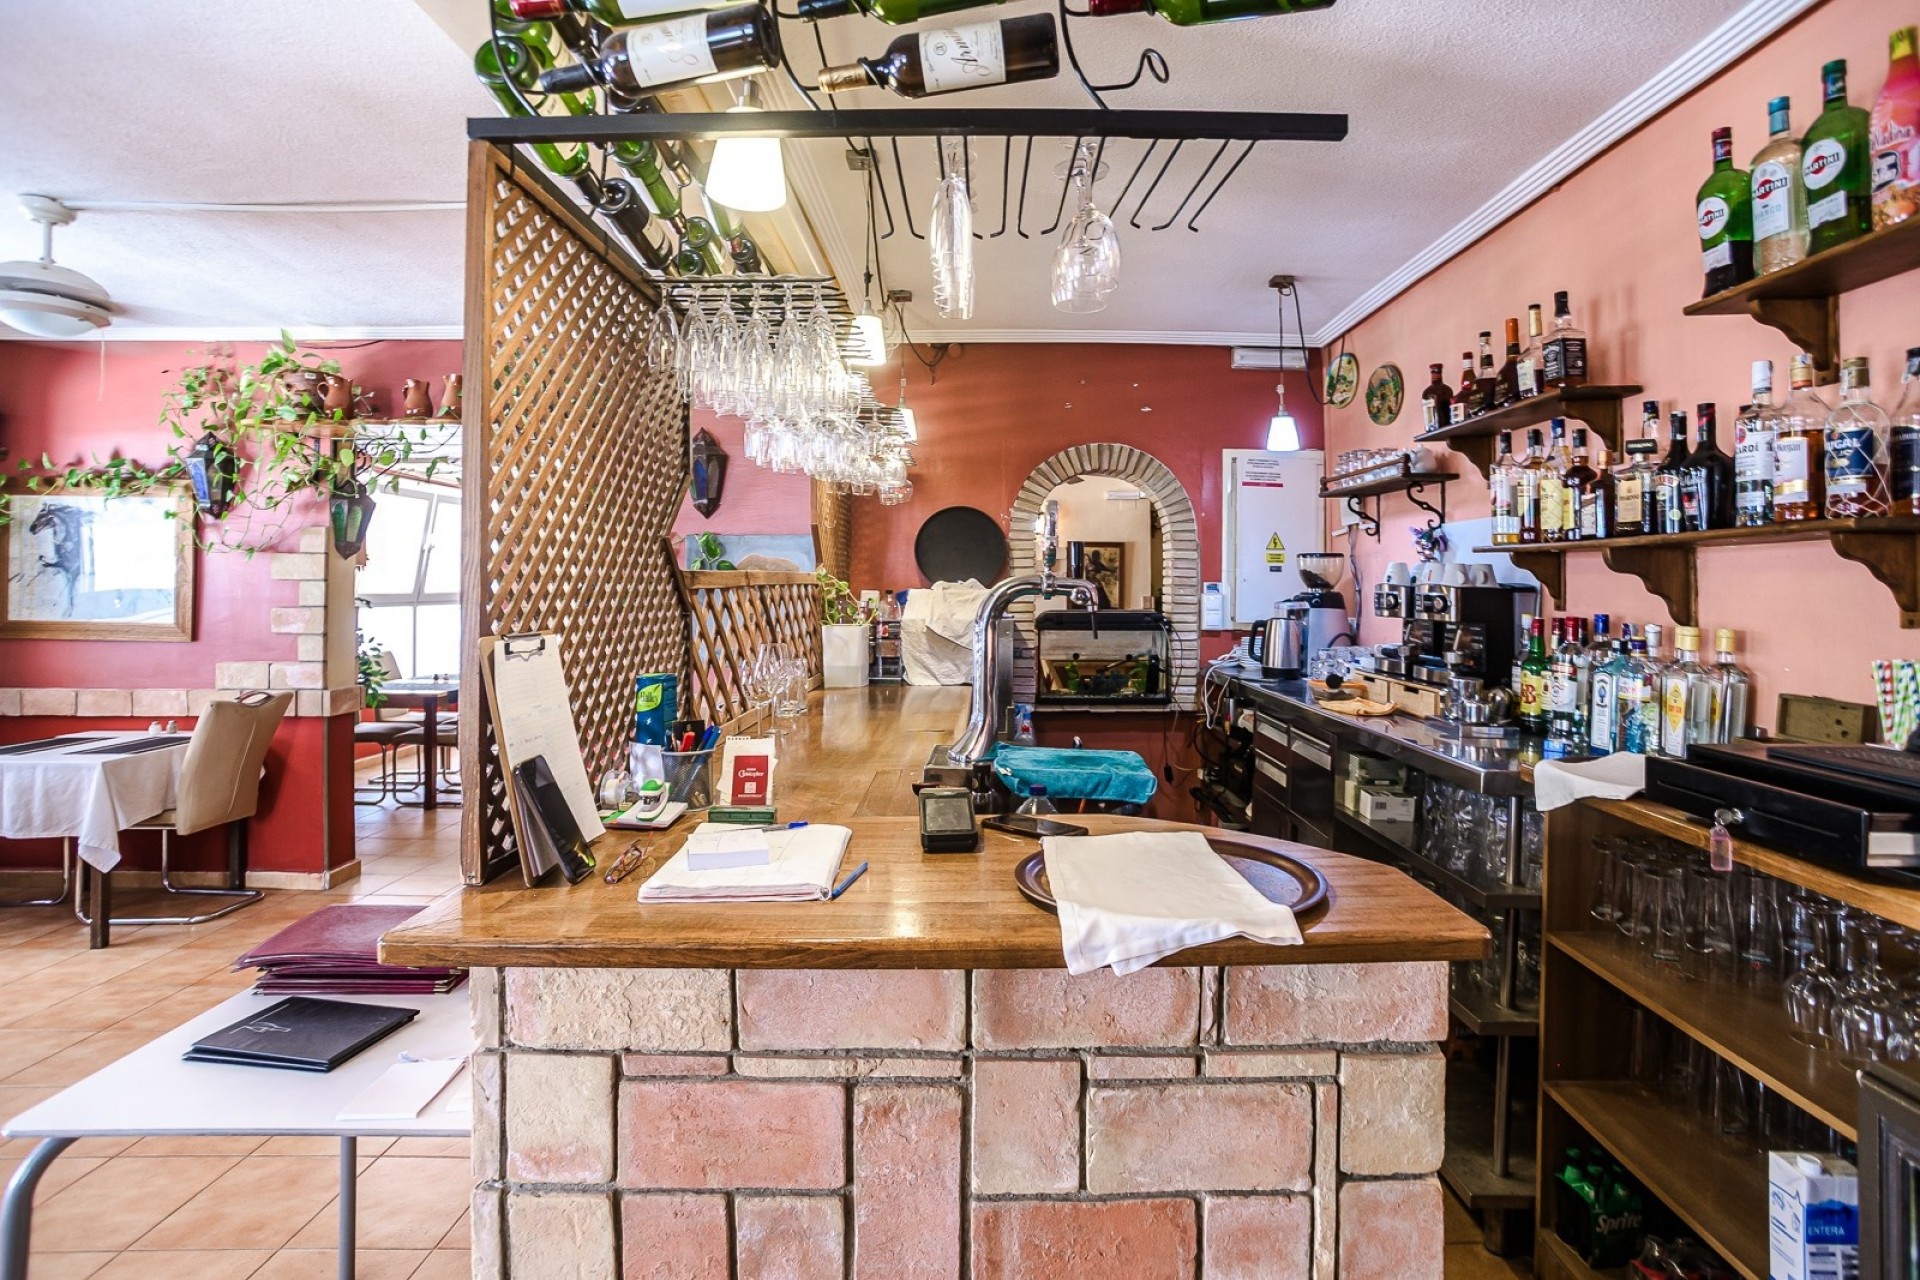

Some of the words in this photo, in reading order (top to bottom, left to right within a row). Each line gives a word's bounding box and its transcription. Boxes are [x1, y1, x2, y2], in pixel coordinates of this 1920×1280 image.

[1803, 152, 1839, 176] MARTINI
[1596, 1212, 1642, 1235] Sprite
[1807, 1225, 1845, 1236] ENTERA
